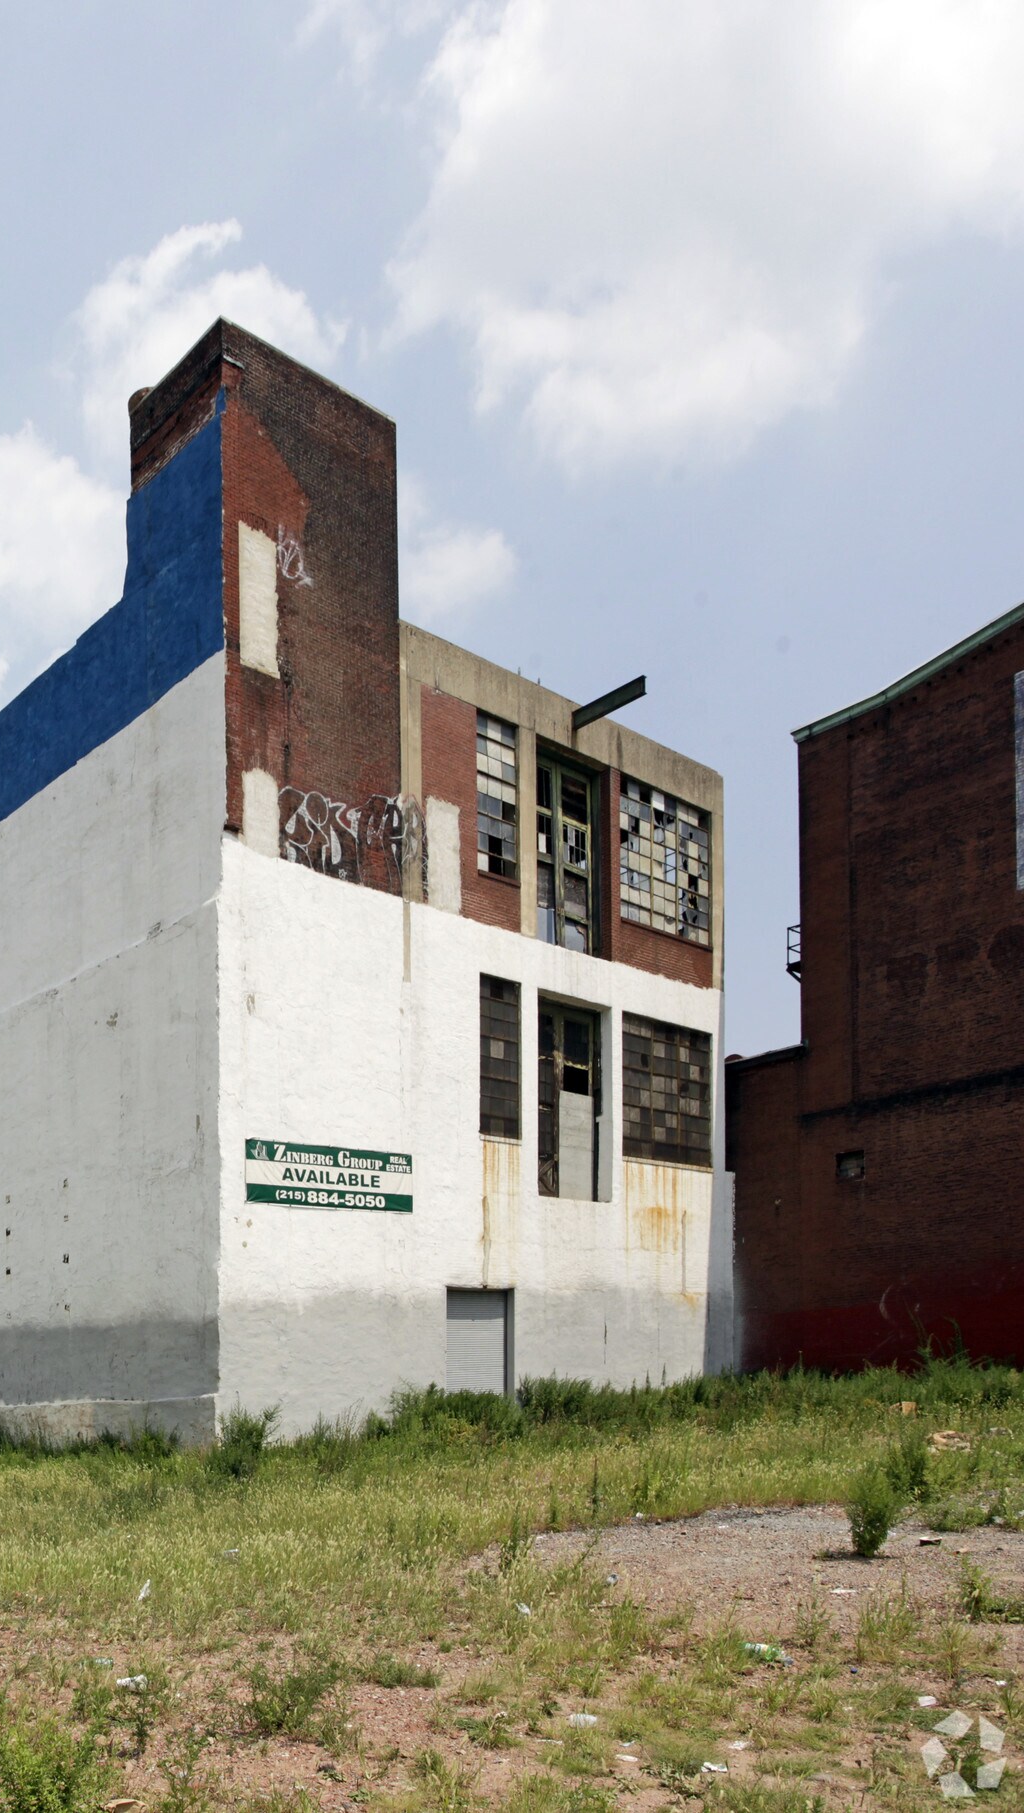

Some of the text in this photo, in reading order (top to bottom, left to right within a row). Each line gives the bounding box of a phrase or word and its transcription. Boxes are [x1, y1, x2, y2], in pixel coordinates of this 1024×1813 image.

[273, 1144, 383, 1171] ZINBERG GROUP
[389, 1155, 407, 1165] REAL
[282, 1167, 381, 1188] AVAILABLE
[386, 1164, 411, 1173] ESTATE
[275, 1189, 386, 1208] (215) 884-5050
